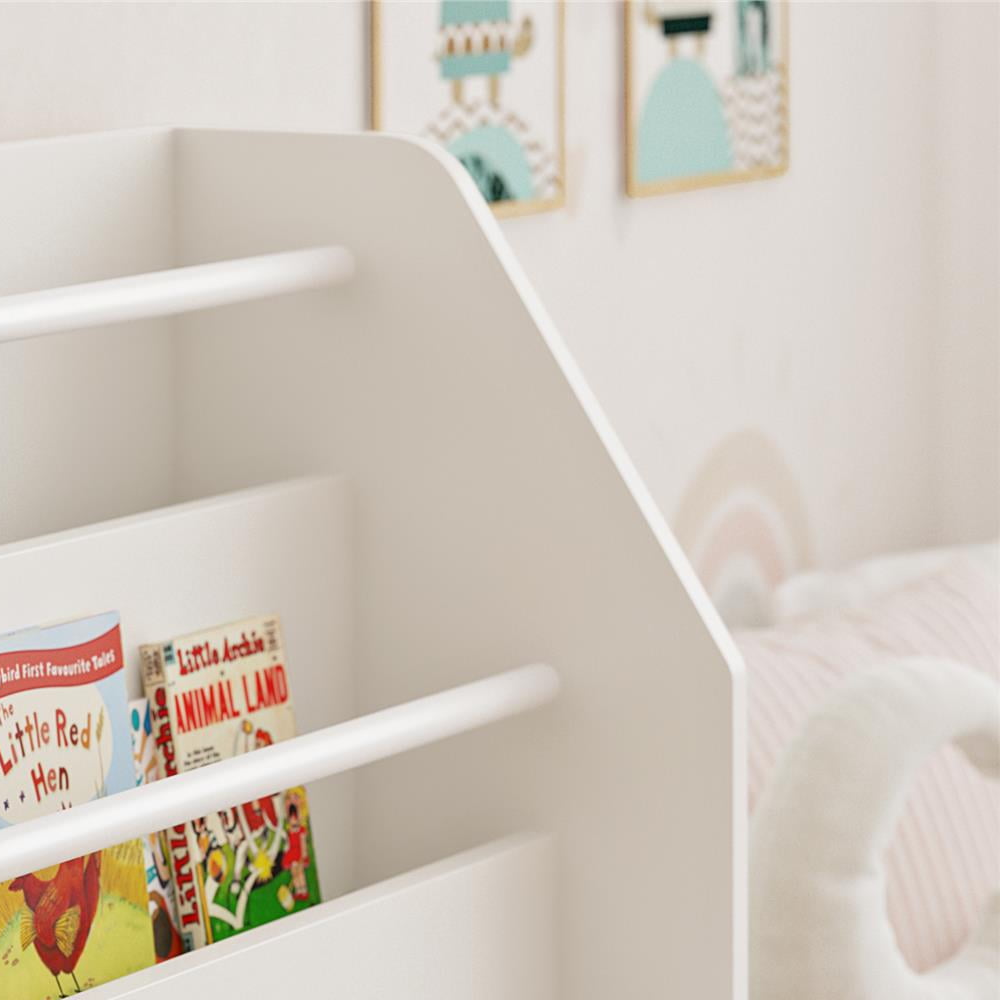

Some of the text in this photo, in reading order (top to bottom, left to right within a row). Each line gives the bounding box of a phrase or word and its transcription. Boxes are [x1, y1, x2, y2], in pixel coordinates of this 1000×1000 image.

[23, 663, 45, 679] First
[46, 656, 91, 678] Favourite
[91, 648, 116, 671] Tales
[176, 642, 219, 676] Little
[174, 664, 288, 735] ANIMAL LAND
[55, 708, 92, 751] Red
[30, 762, 70, 803] Hen
